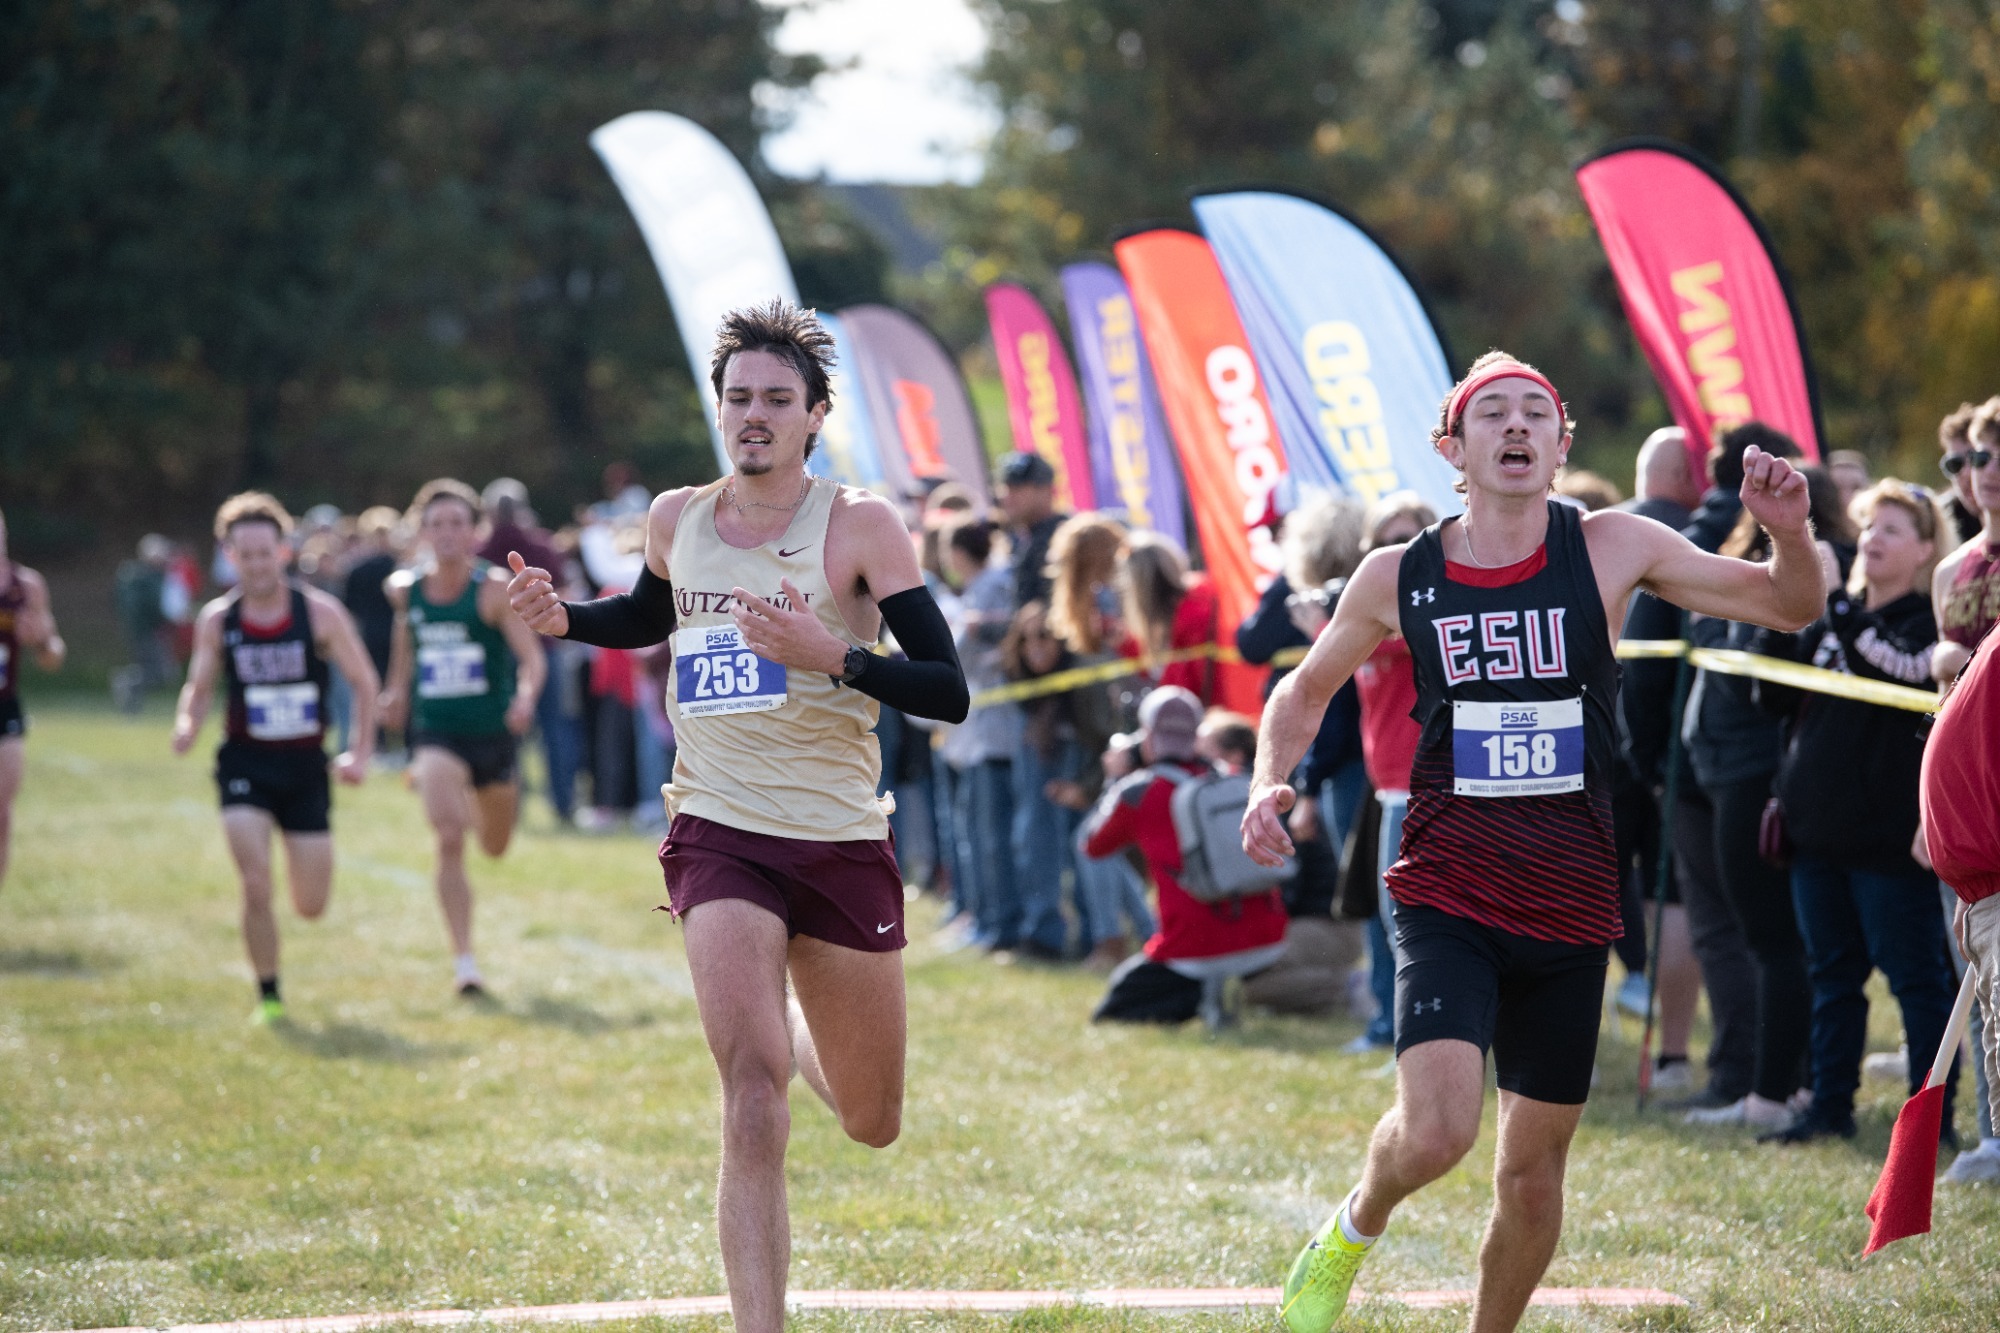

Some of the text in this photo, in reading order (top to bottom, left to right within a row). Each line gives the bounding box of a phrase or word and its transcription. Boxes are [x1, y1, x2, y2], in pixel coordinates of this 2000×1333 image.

[705, 632, 738, 645] PSAC
[1431, 607, 1568, 687] ESU
[693, 652, 760, 699] 253
[1501, 711, 1538, 723] PSAC
[1482, 732, 1557, 777] 158
